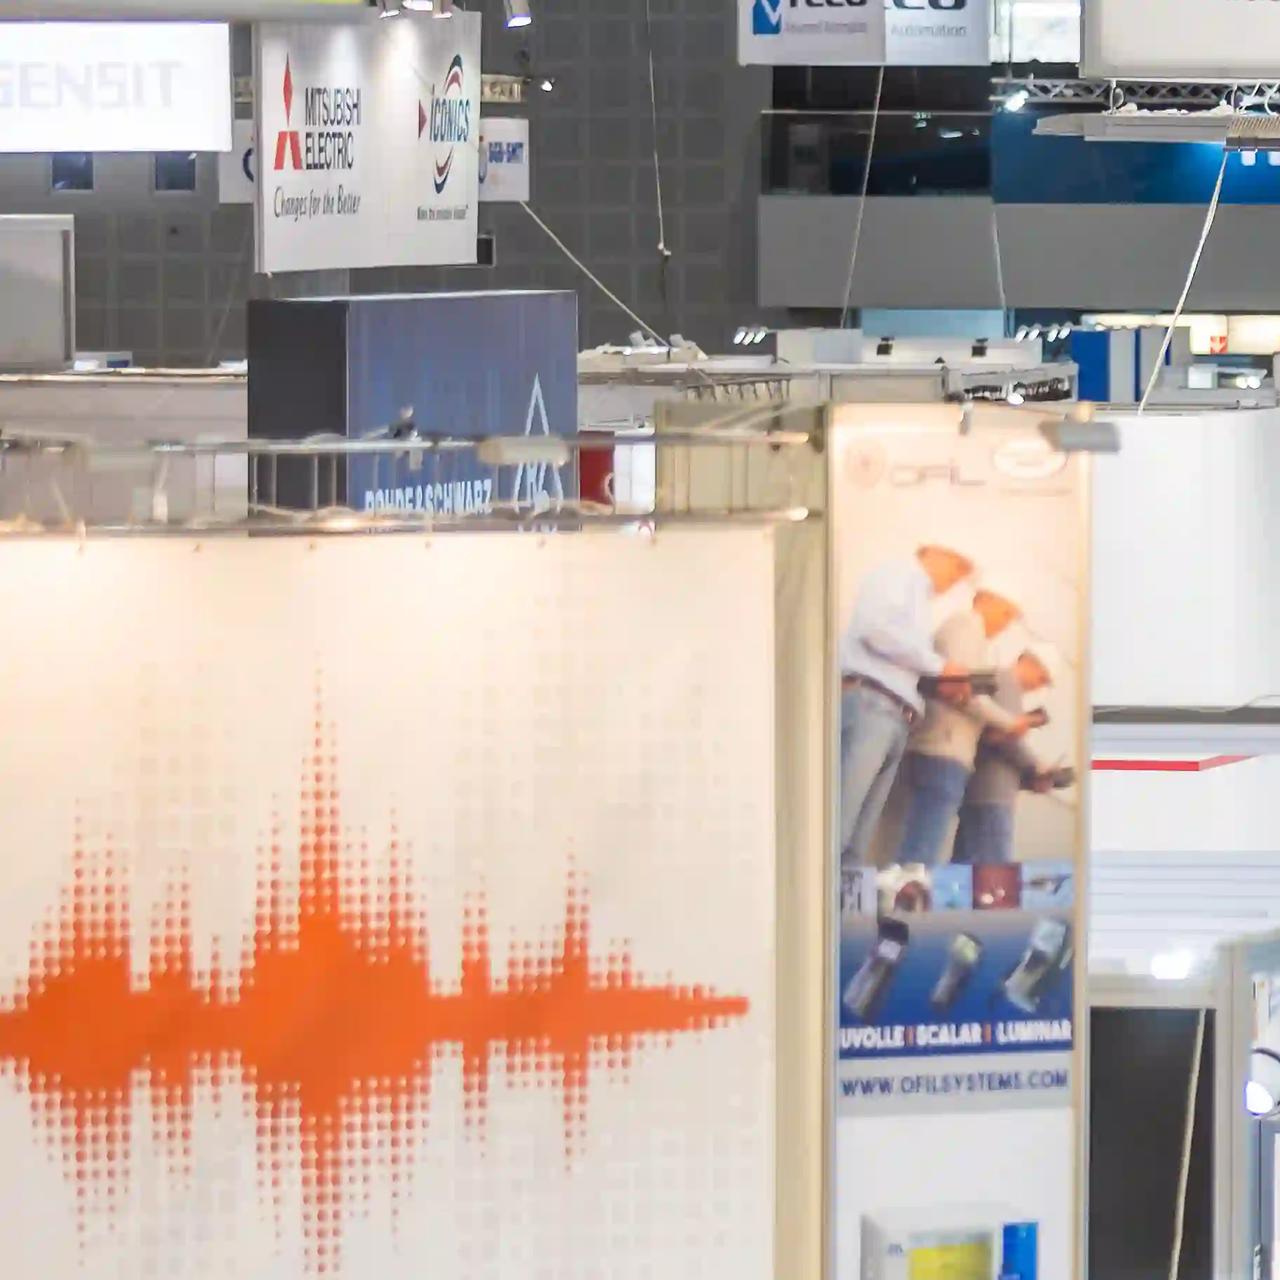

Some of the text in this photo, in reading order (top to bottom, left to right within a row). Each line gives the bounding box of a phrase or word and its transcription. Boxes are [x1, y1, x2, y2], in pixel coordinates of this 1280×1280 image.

[305, 87, 361, 126] MITSUBISHI
[305, 131, 354, 171] ELECTRIC
[273, 185, 308, 222] Changes
[337, 184, 361, 213] Better
